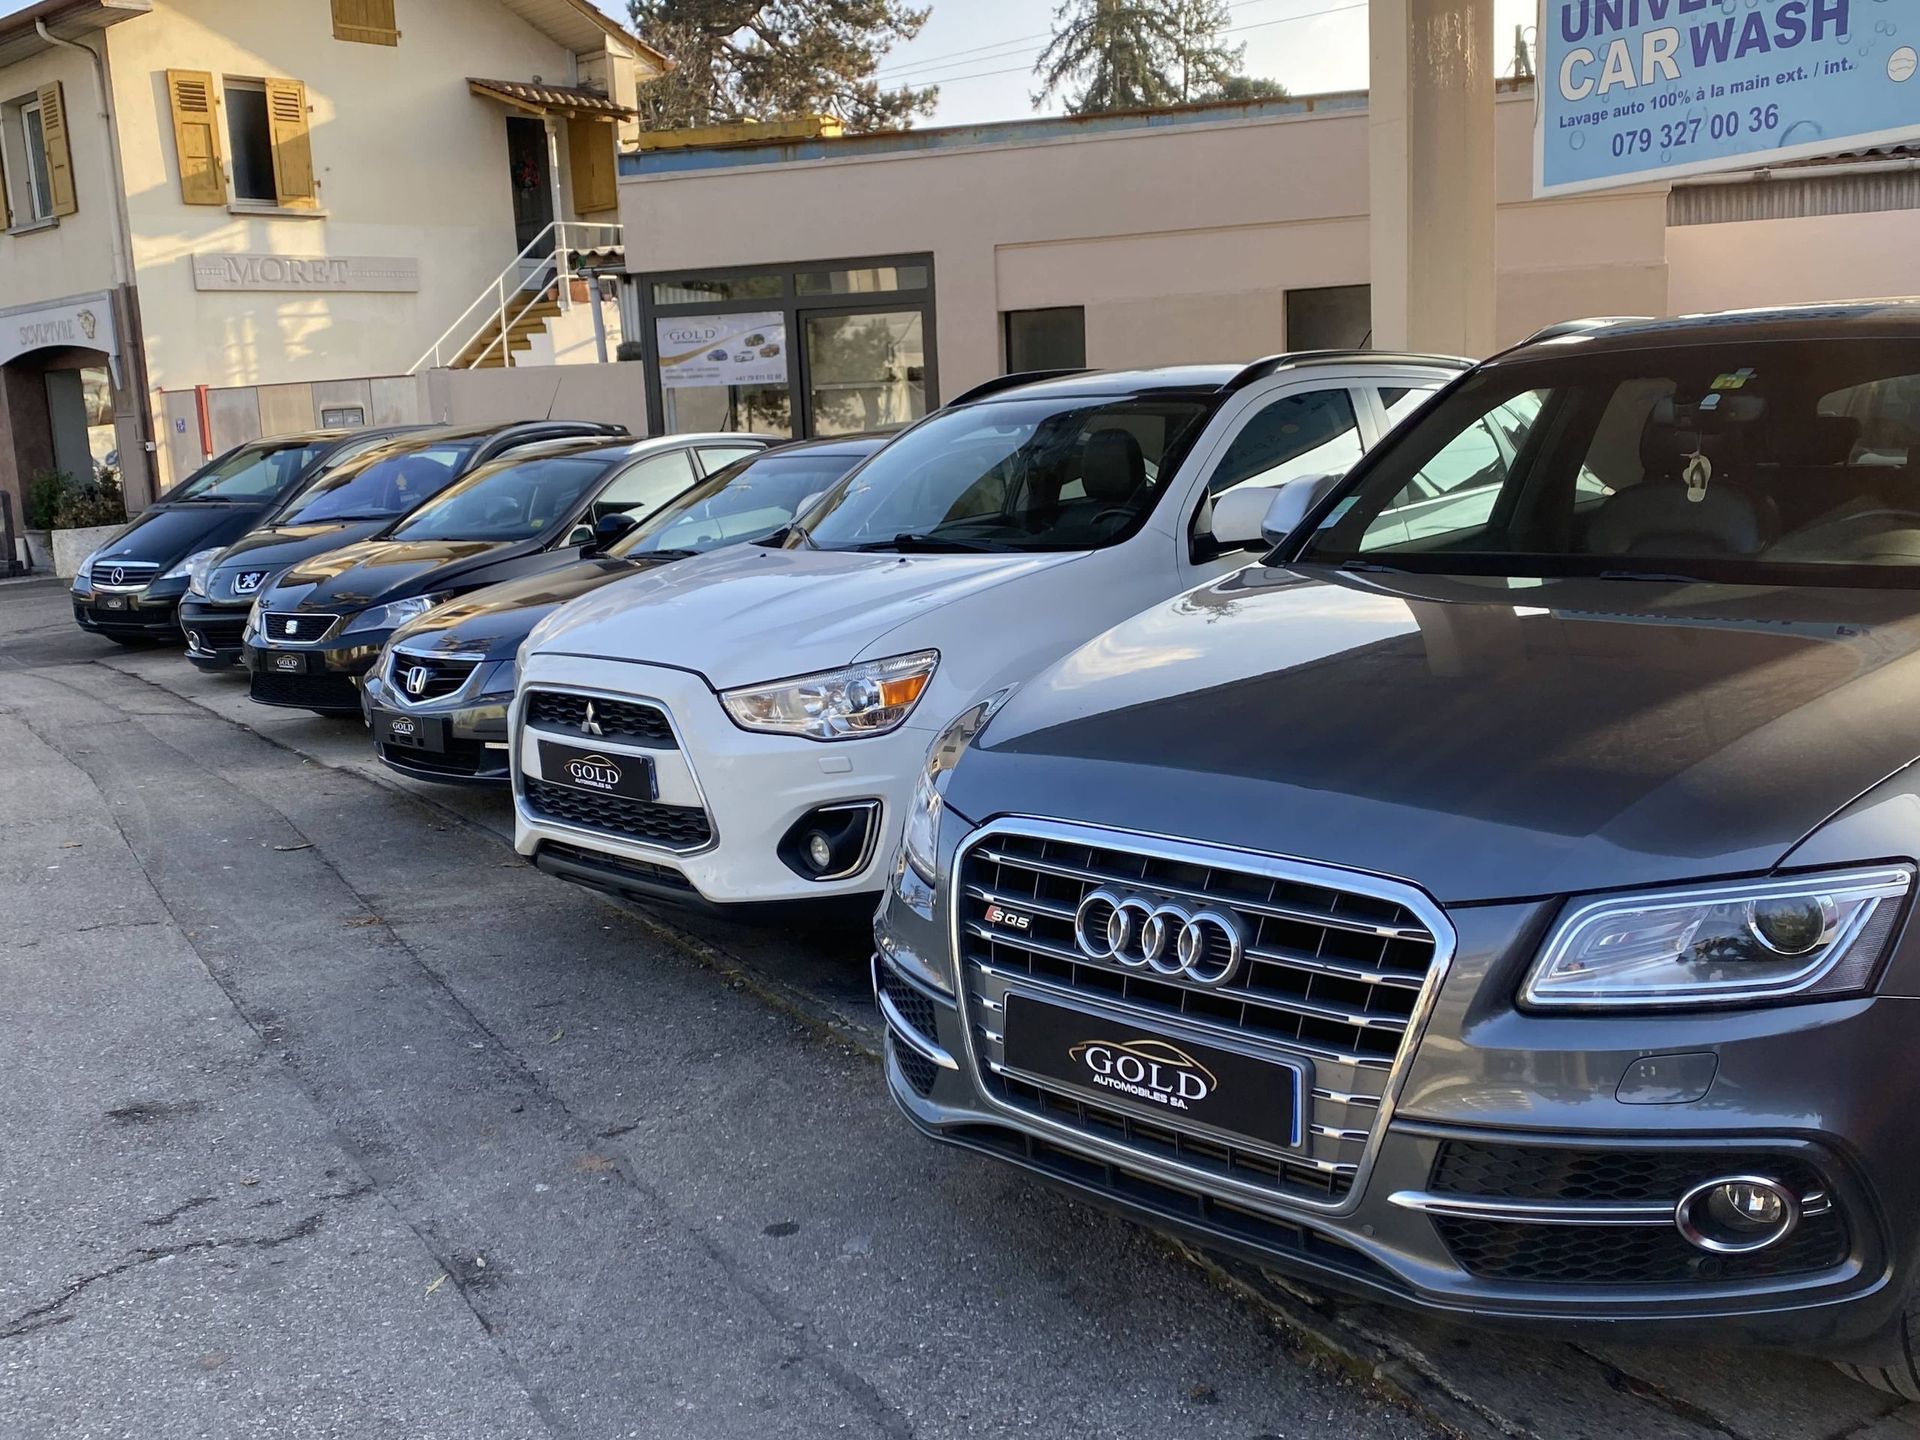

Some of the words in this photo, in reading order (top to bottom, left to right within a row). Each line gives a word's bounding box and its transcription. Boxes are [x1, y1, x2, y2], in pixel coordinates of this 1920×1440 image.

[1558, 27, 1682, 101] CAR
[1690, 0, 1849, 67] WASH
[1559, 110, 1608, 129] Lavage
[1613, 102, 1645, 118] auto
[1650, 90, 1690, 110] 100%
[1696, 87, 1705, 101] à
[1711, 84, 1724, 98] la
[1730, 75, 1770, 94] main
[1776, 66, 1808, 84] ext.
[1813, 62, 1819, 77] /
[1824, 57, 1853, 75] int.
[1612, 128, 1651, 157] 079
[1660, 118, 1702, 149] 327
[1710, 111, 1739, 139] 00
[1749, 103, 1779, 132] 36
[223, 256, 348, 285] MORET
[669, 329, 716, 341] GOLD
[392, 721, 414, 732] GOLD
[570, 763, 619, 784] GOLD
[992, 910, 1029, 928] SQ5
[1085, 1047, 1207, 1100] GOLD
[1093, 1074, 1168, 1104] AUTOMOBILES
